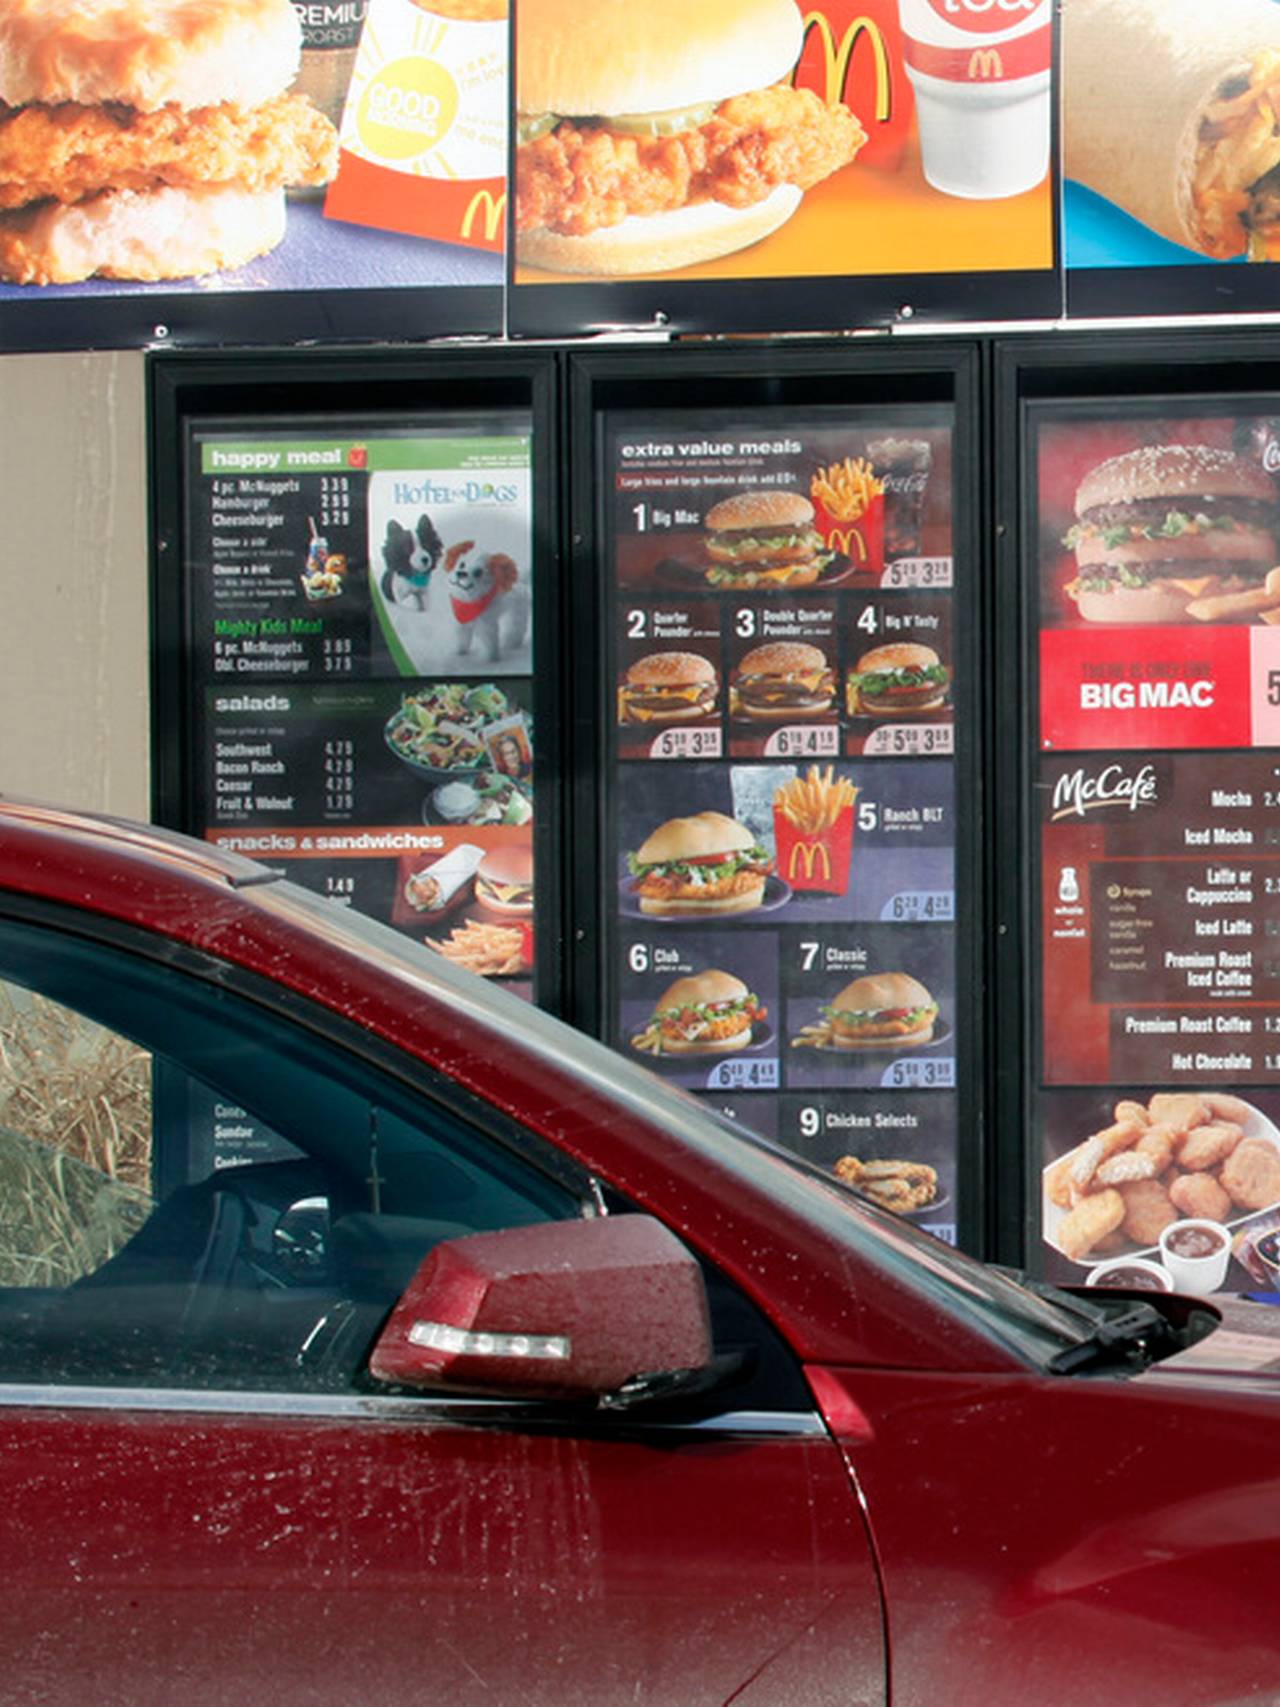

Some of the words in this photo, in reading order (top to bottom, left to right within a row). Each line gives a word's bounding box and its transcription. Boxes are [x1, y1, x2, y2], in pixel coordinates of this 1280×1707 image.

[369, 83, 441, 119] GOOD
[622, 443, 674, 458] extra
[679, 442, 734, 456] value
[739, 439, 802, 455] meals
[212, 450, 281, 468] happy
[287, 449, 341, 464] meal
[239, 480, 300, 494] McNuggets
[212, 497, 271, 510] Hamburger
[212, 514, 285, 528] Cheeseburger
[632, 503, 645, 532] 1
[653, 511, 671, 527] Big
[675, 510, 700, 525] Mac
[627, 610, 646, 638] 2
[654, 612, 688, 625] Quarter
[736, 609, 754, 638] 3
[763, 610, 796, 622] Double
[798, 609, 833, 623] Quarter
[857, 606, 877, 634] 4
[885, 615, 900, 629] Big
[214, 619, 257, 638] Mighty
[259, 619, 287, 634] Kids
[654, 627, 692, 638] Pounder
[243, 641, 302, 656] McNuggets
[237, 658, 309, 674] Cheeseburger
[1080, 683, 1136, 709] BIG
[1139, 681, 1214, 708] MAC
[216, 695, 290, 712] salads
[216, 744, 273, 757] Southwest
[216, 761, 249, 774] Bacon
[252, 761, 284, 774] Ranch
[216, 779, 252, 792] Caesar
[1053, 765, 1158, 816] McCafé
[216, 797, 243, 810] Fruit
[256, 797, 294, 810] Walnut
[1211, 790, 1252, 807] Mocha
[858, 803, 877, 831] 5
[884, 807, 920, 822] Ranch
[923, 807, 943, 822] BLT
[217, 837, 297, 850] snacks
[301, 838, 314, 849] &
[316, 833, 445, 850] sandwiches
[1185, 828, 1210, 844] Iced
[1213, 828, 1252, 844] Mocha
[1186, 887, 1252, 905] Cappuccino
[1195, 919, 1219, 935] Iced
[1222, 919, 1252, 935] Latte
[629, 944, 648, 972] 6
[654, 949, 679, 962] Club
[800, 943, 819, 971] 7
[826, 947, 867, 962] Classic
[1165, 951, 1216, 967] Premium
[1219, 951, 1252, 967] Roast
[1187, 971, 1212, 986] Iced
[1215, 971, 1252, 986] Coffee
[1125, 1017, 1178, 1033] Premium
[1180, 1017, 1213, 1032] Roast
[1216, 1017, 1252, 1032] Coffee
[1172, 1055, 1193, 1070] Hot
[1196, 1053, 1252, 1070] Chocolate
[800, 1107, 818, 1136] 9
[826, 1113, 871, 1127] Chicken
[875, 1112, 918, 1128] Selects
